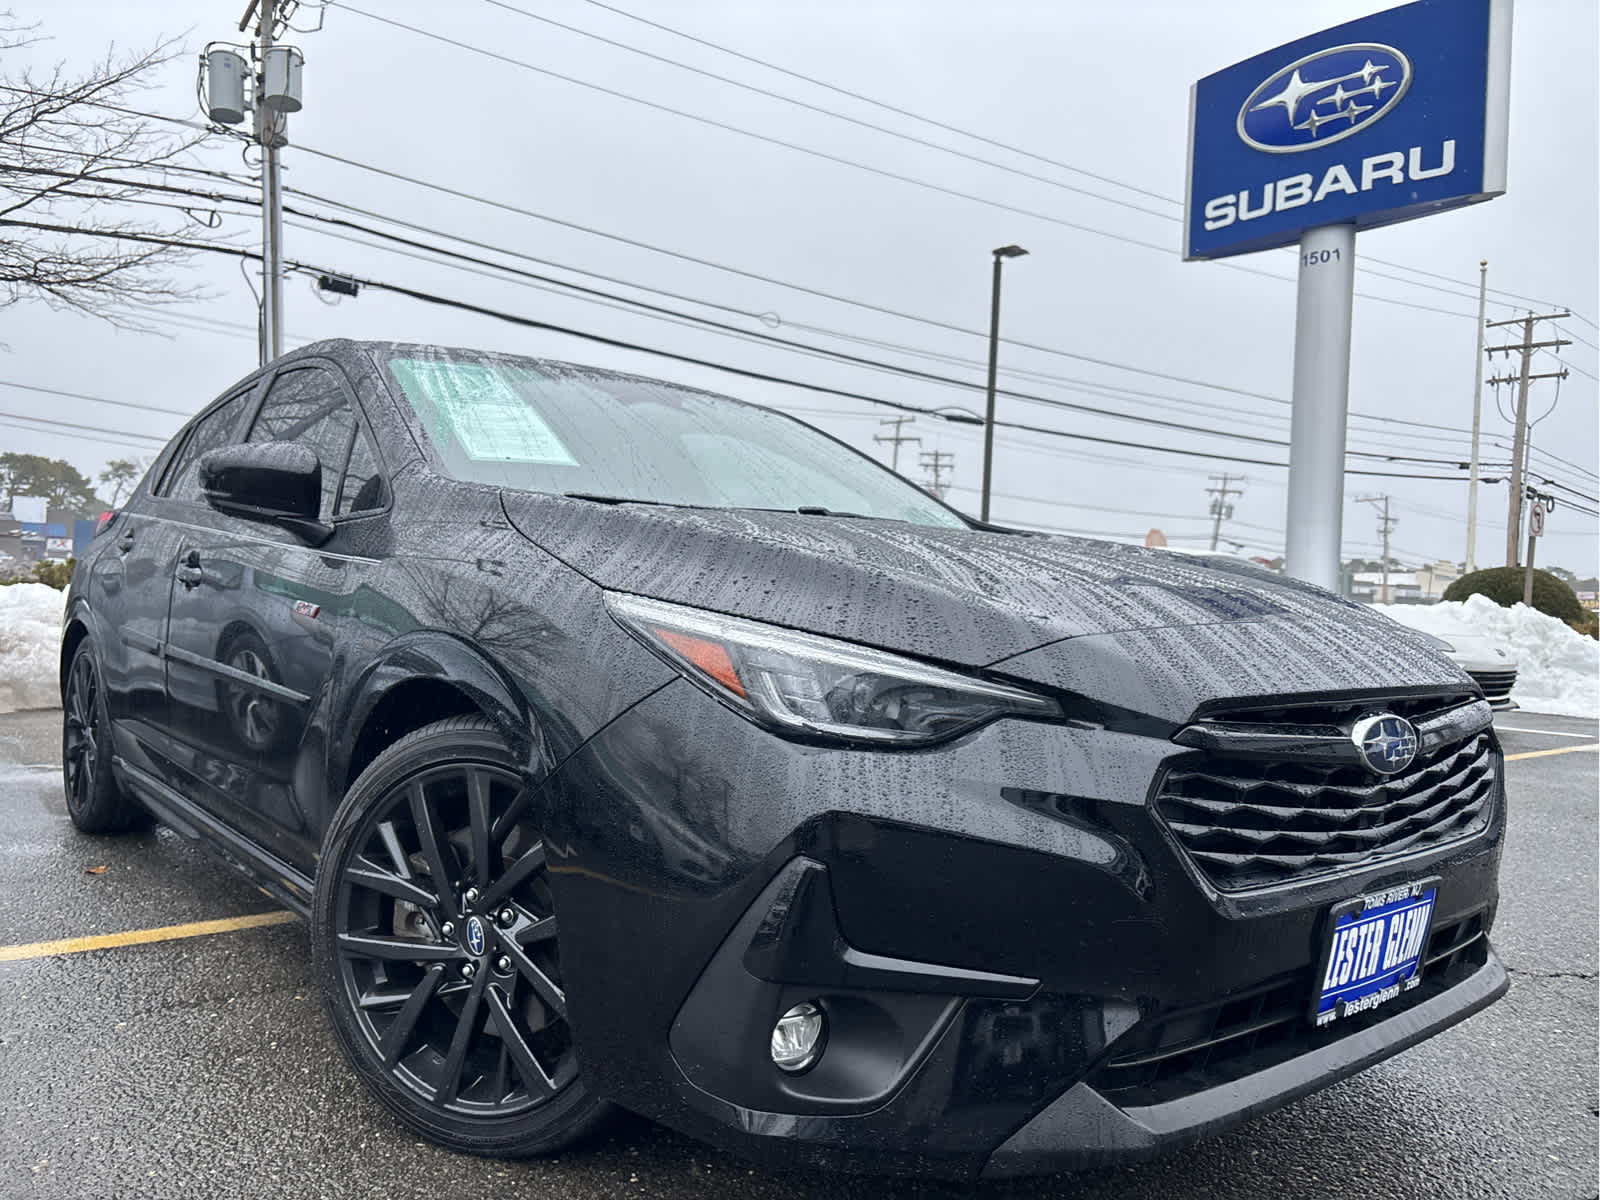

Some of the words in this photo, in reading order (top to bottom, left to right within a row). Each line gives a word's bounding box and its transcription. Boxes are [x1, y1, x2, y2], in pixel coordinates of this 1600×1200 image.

[1204, 139, 1456, 231] SUBARU
[1303, 248, 1340, 267] 1501
[1322, 919, 1385, 990] LESTER
[1382, 903, 1431, 971] GLENN
[1343, 986, 1400, 1017] lesterglenn
